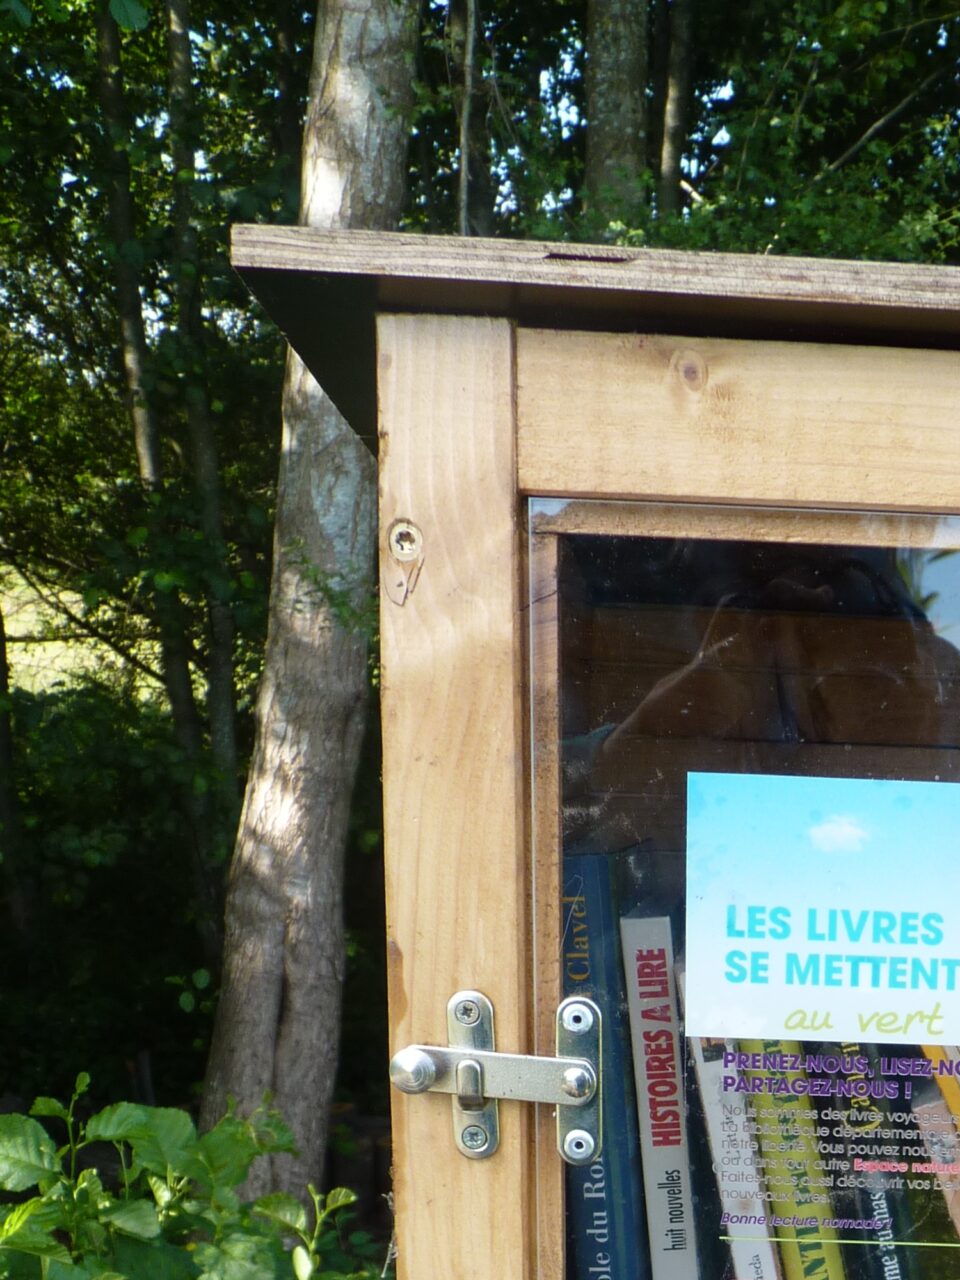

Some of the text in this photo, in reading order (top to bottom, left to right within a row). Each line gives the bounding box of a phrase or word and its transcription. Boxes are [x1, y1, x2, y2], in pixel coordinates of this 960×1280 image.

[560, 896, 590, 981] Clavel
[726, 904, 944, 946] LES LIVRES
[724, 950, 769, 984] SE
[783, 1008, 834, 1032] au
[857, 1002, 945, 1036] vert
[635, 948, 682, 1146] HISTOIRES A LIRE
[722, 1051, 875, 1078] PRENEZ-NOUS,
[722, 1075, 899, 1099] PARTAGEZ-NOUS
[722, 1103, 757, 1118] Nous
[821, 1107, 847, 1121] des
[849, 1108, 885, 1122] livres
[812, 1141, 845, 1154] Vous
[847, 1143, 899, 1157] pouvez
[907, 1178, 931, 1190] vos
[586, 1210, 609, 1243] du
[657, 1169, 687, 1252] huit nouvelles
[720, 1212, 766, 1228] Bonne
[769, 1214, 818, 1229] lecture
[821, 1218, 885, 1231] nomade
